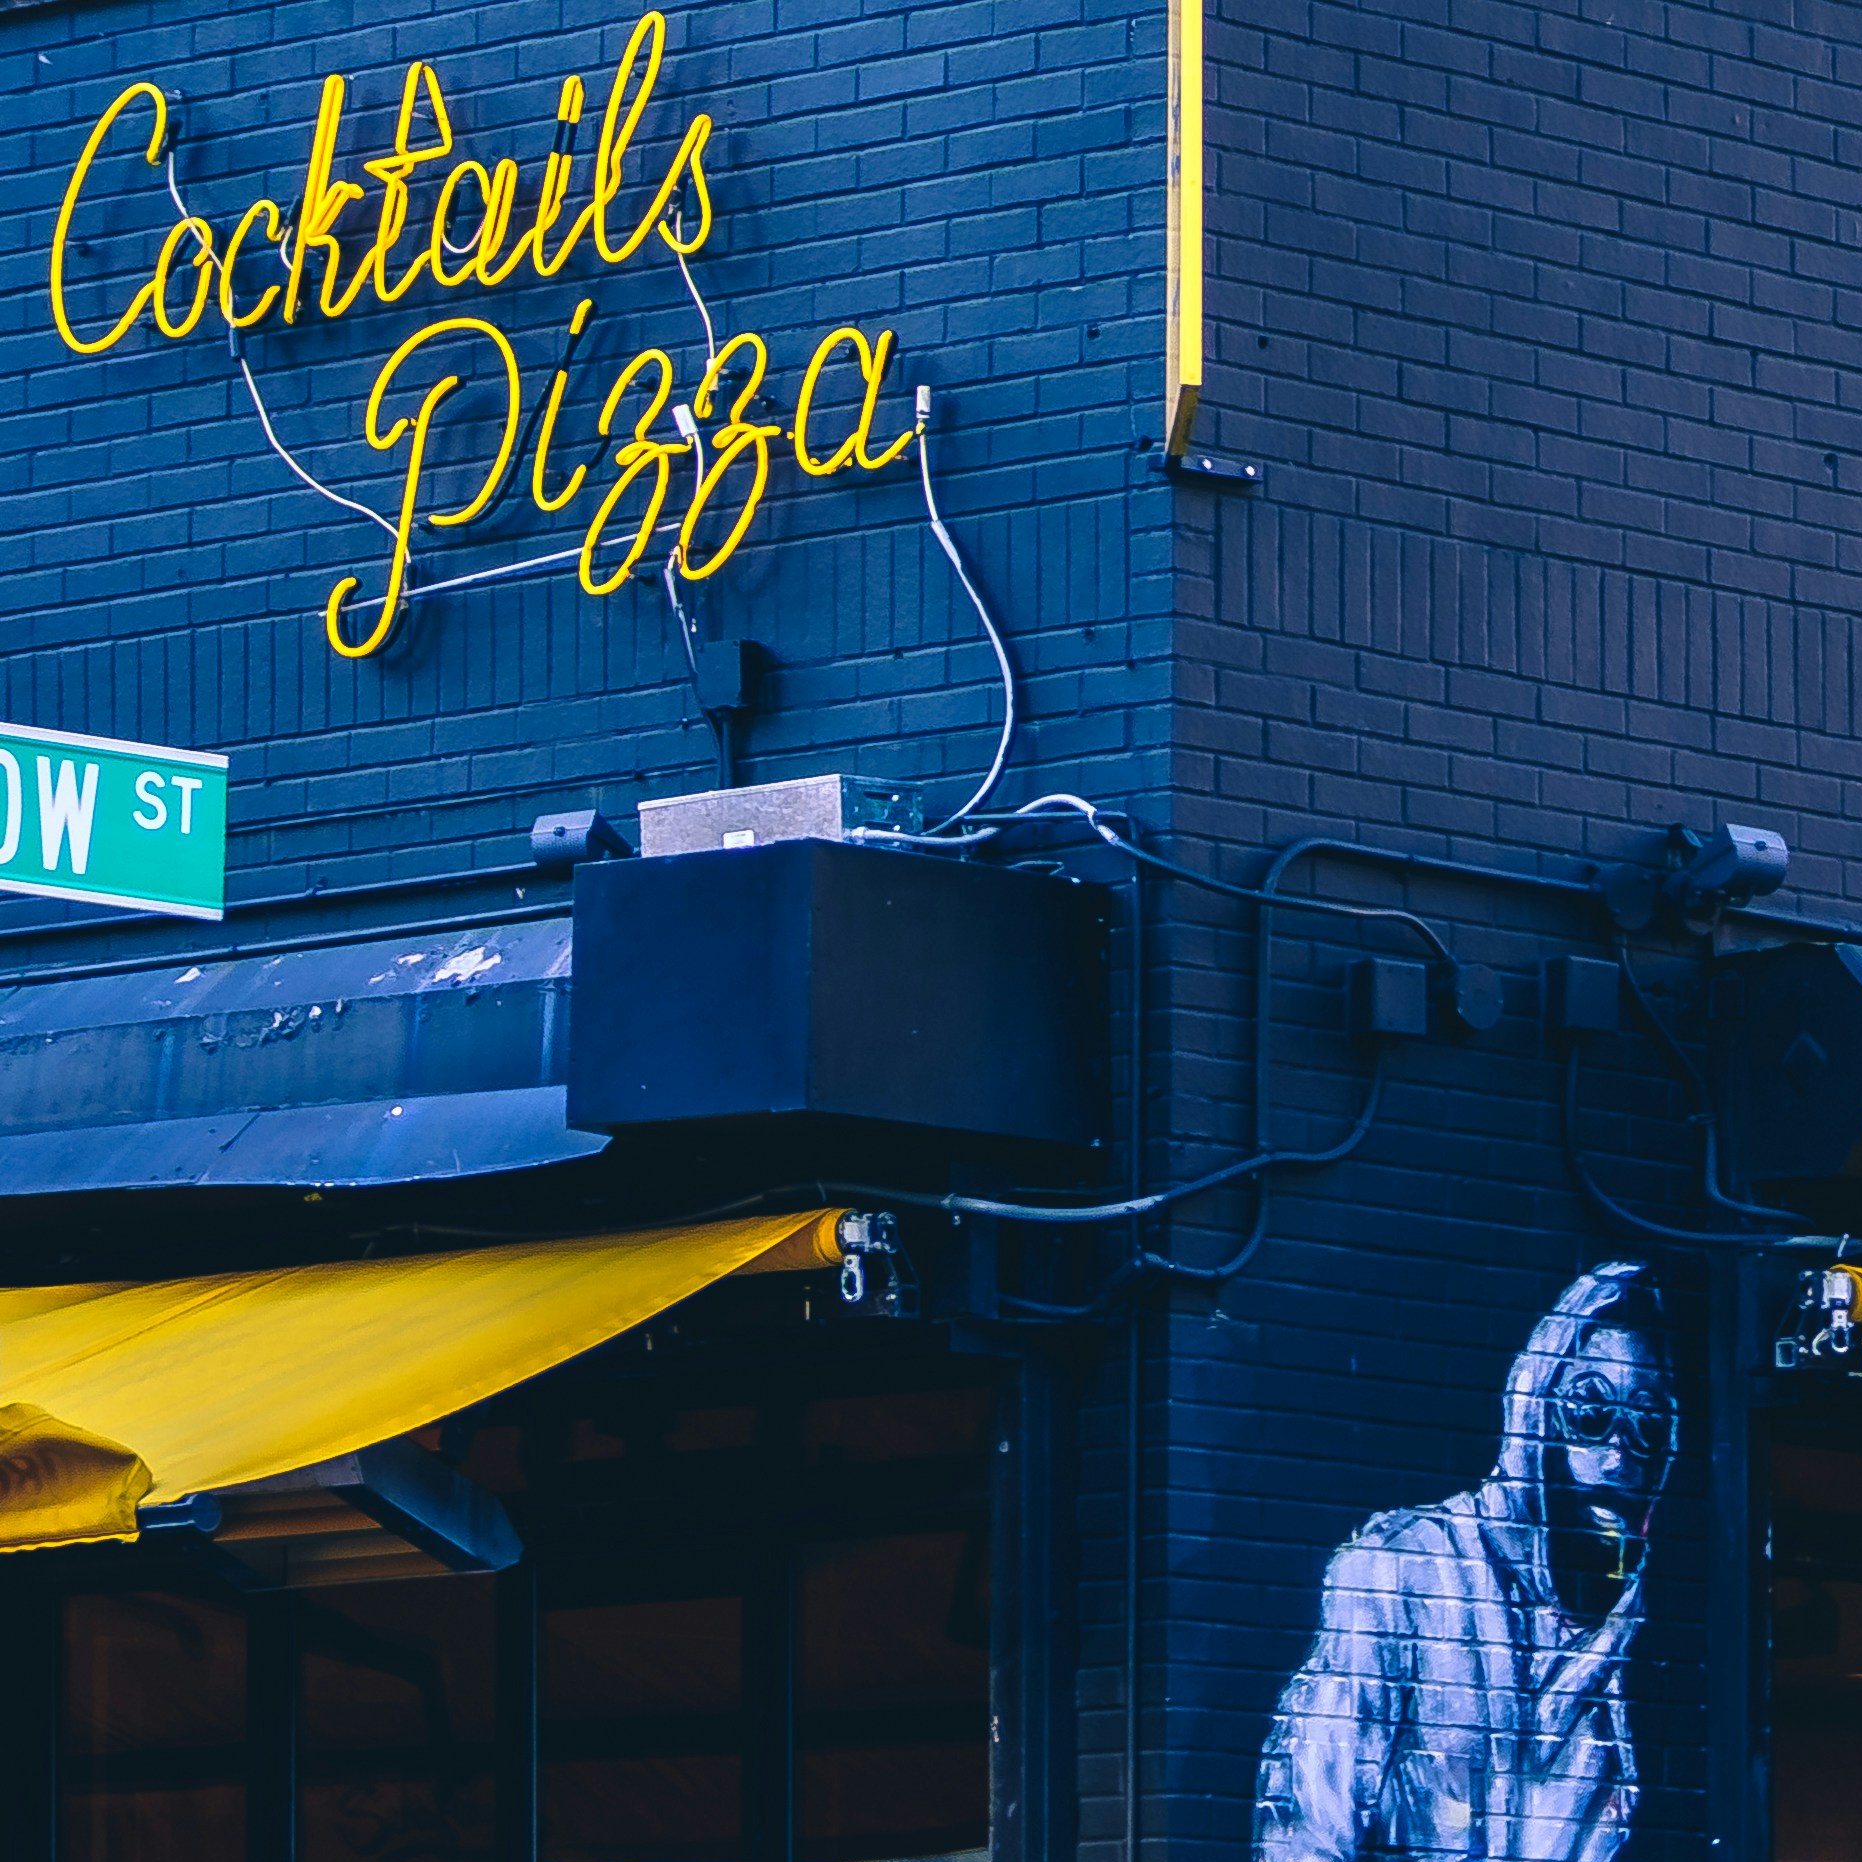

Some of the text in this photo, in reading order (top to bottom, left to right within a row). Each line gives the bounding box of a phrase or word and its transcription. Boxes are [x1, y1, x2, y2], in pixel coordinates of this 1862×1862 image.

[50, 10, 714, 355] Cocktails
[325, 298, 918, 658] Pizza
[133, 771, 203, 834] ST
